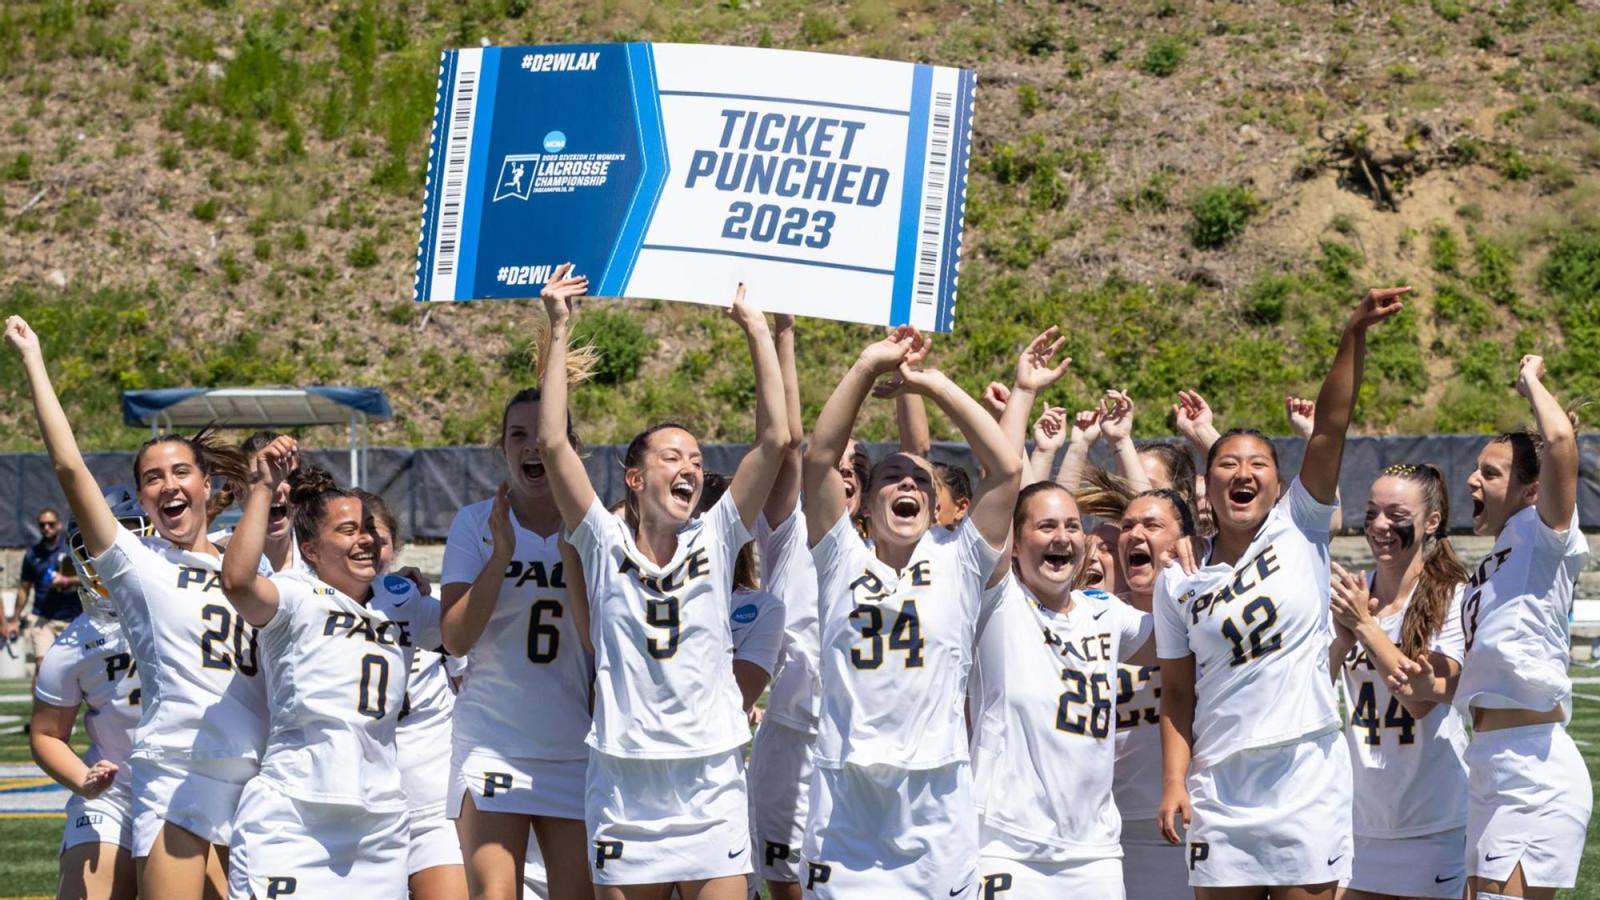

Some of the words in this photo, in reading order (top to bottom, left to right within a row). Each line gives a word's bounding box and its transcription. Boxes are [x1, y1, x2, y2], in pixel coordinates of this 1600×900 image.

[521, 52, 600, 73] #D2WLAX
[718, 109, 866, 160] TICKET
[535, 176, 607, 187] CHAMPIONSHIP
[537, 161, 610, 175] LACROSSE
[684, 150, 890, 208] PUNCHED
[721, 201, 836, 249] 2023
[497, 263, 576, 286] #D2WLX
[1191, 544, 1280, 625] PACE
[201, 603, 258, 677] 20
[323, 609, 412, 647] PACE
[527, 599, 564, 664] 6
[646, 596, 680, 660] 9
[848, 599, 925, 670] 34
[1043, 626, 1112, 662] PACE
[1221, 595, 1283, 668] 12
[358, 653, 389, 720] 0
[1055, 668, 1112, 740] 26
[1351, 681, 1416, 746] 44
[483, 771, 513, 798] P
[594, 840, 624, 869] P
[765, 841, 789, 867] P
[1189, 842, 1210, 870] P
[266, 876, 297, 900] P
[807, 862, 832, 891] P
[981, 872, 1013, 900] P
